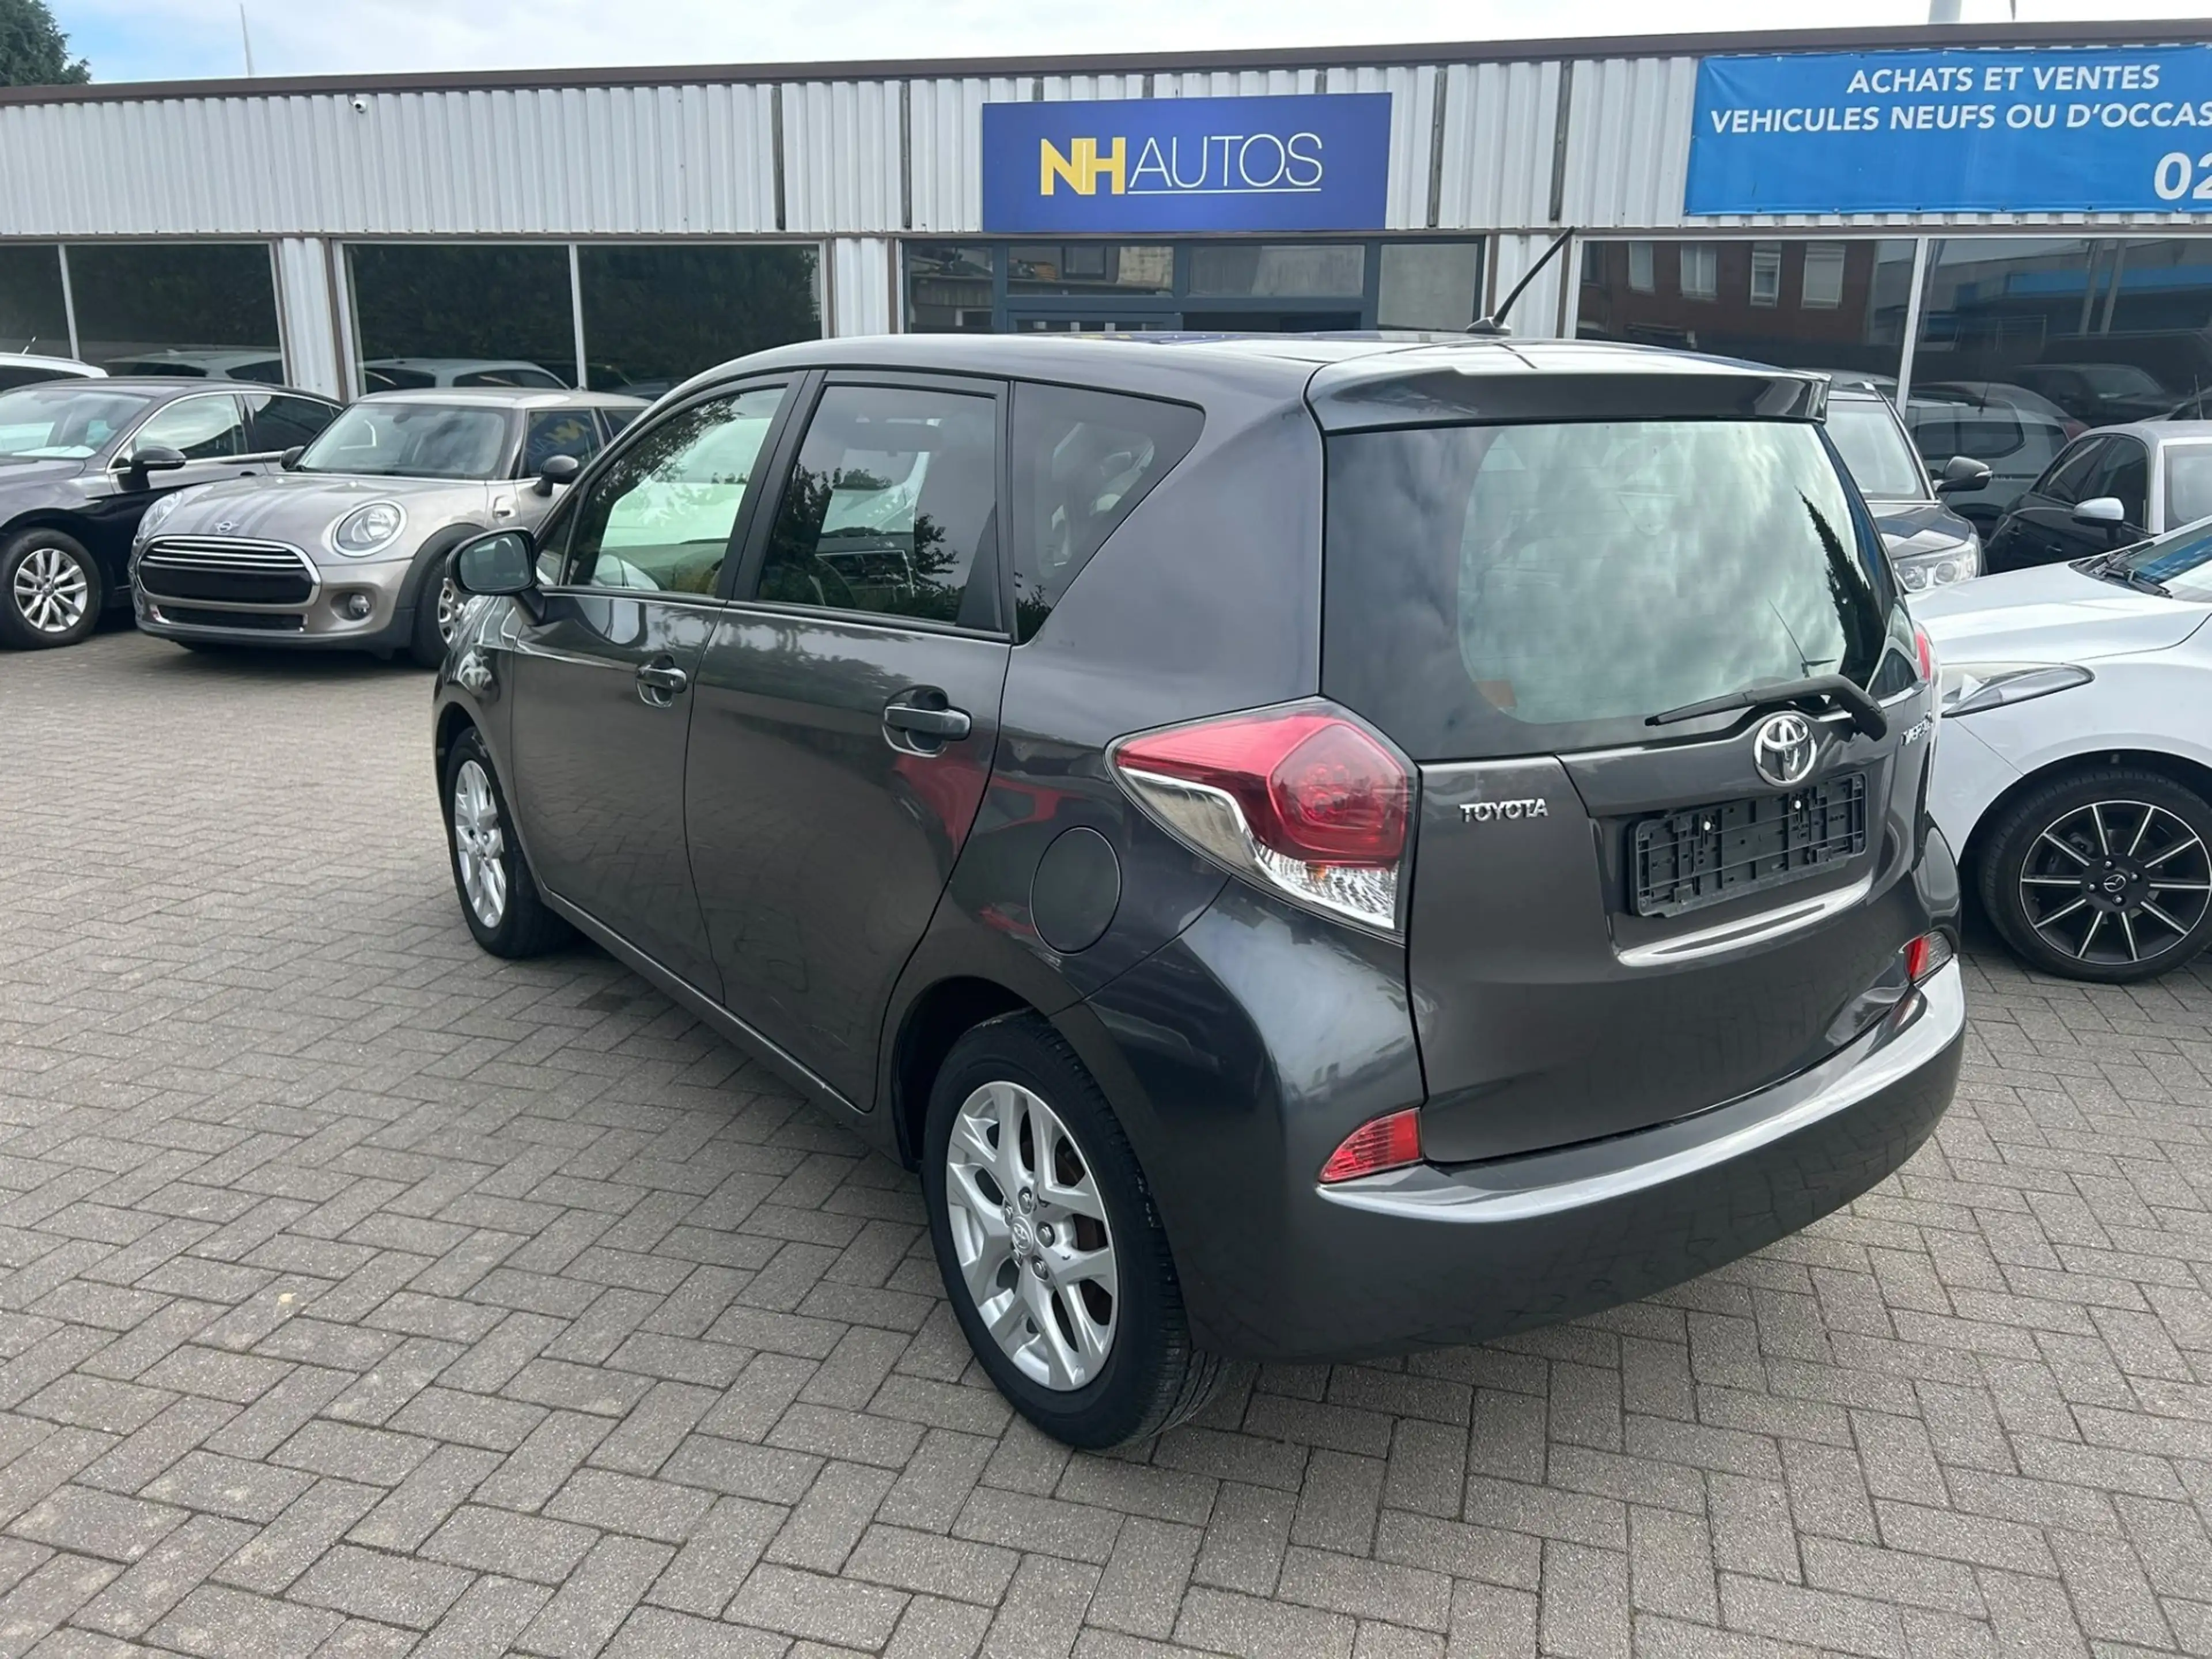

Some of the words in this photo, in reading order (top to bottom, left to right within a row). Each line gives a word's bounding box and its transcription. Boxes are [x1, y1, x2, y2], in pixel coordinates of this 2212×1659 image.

[1846, 67, 1973, 93] ACHATS
[1984, 67, 2024, 91] ET
[2032, 64, 2161, 90] VENTES
[1711, 106, 1880, 134] VEHICULES
[1890, 104, 1996, 130] NEUFS
[2006, 104, 2056, 129] OU
[1459, 798, 1548, 823] TOYOTA
